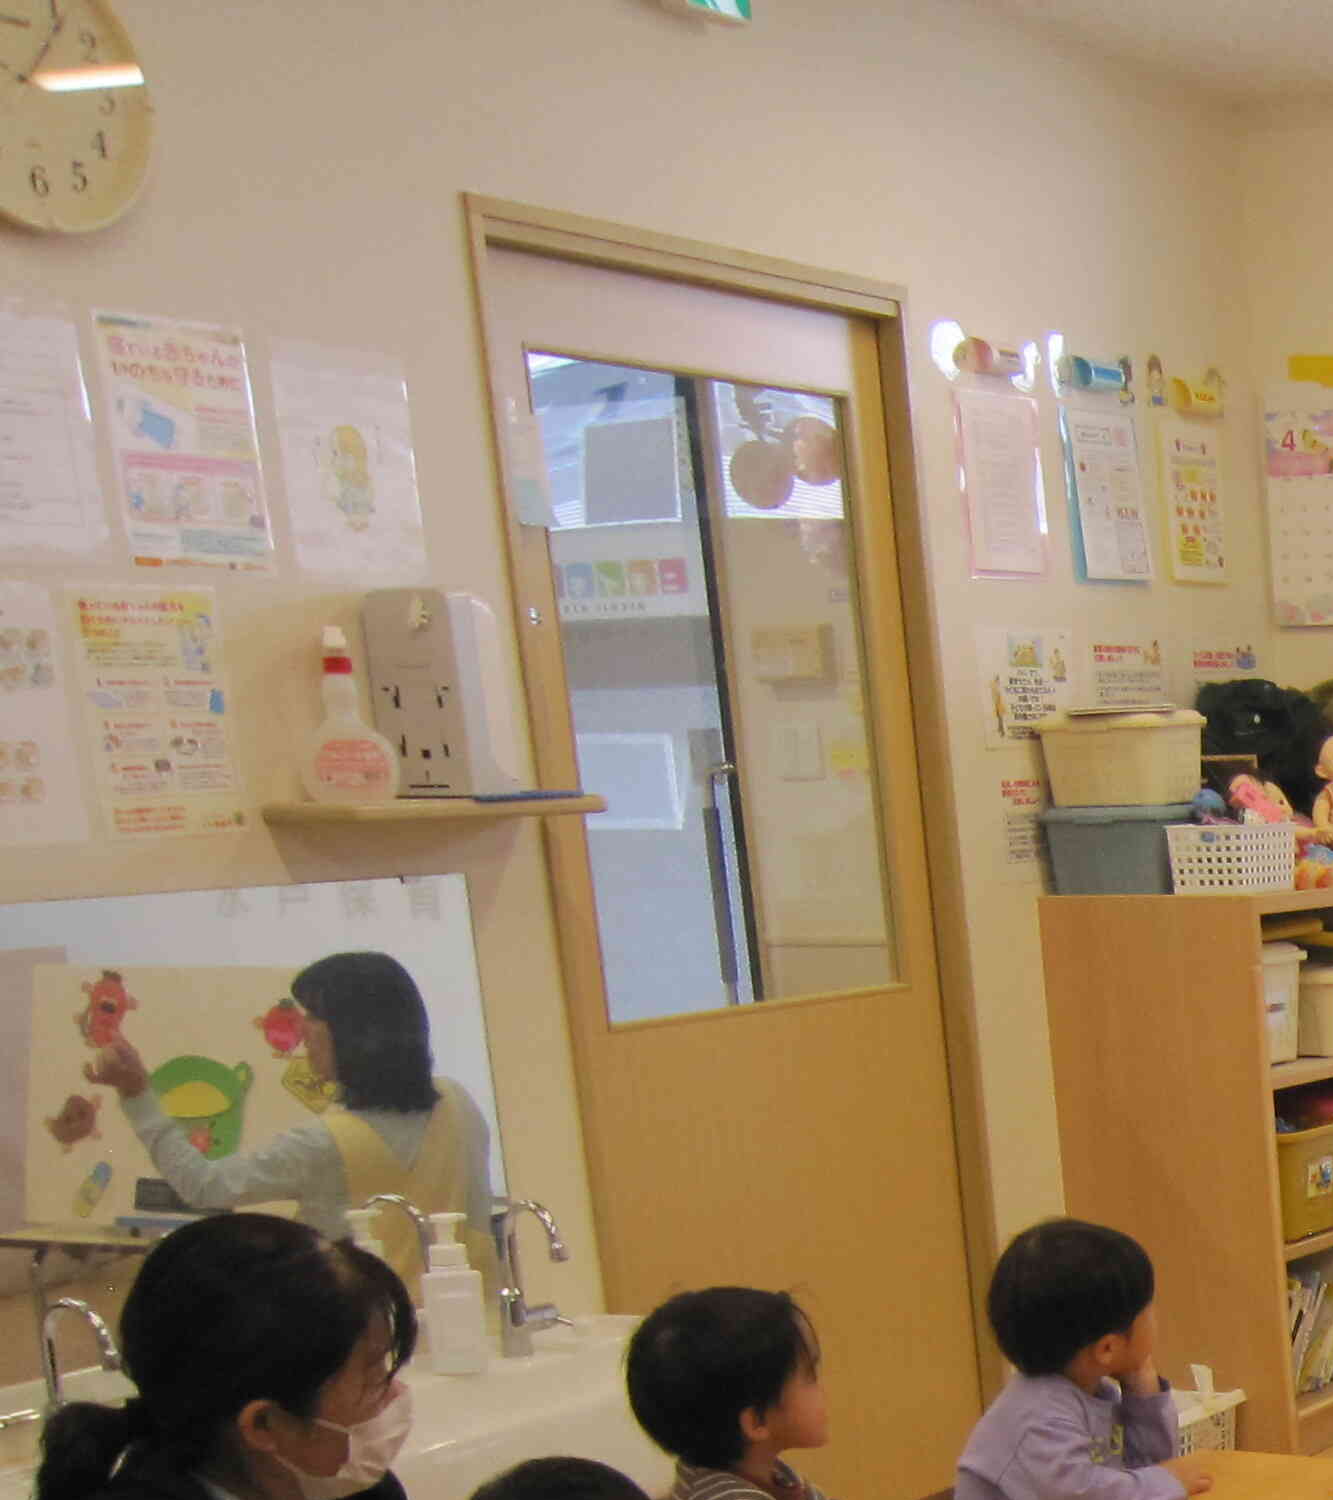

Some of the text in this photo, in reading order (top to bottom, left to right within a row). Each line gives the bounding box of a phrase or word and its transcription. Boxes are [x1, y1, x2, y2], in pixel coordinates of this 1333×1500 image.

[90, 130, 108, 160] 4
[29, 164, 49, 198] 6
[71, 159, 88, 193] 5
[1281, 430, 1297, 451] 4
